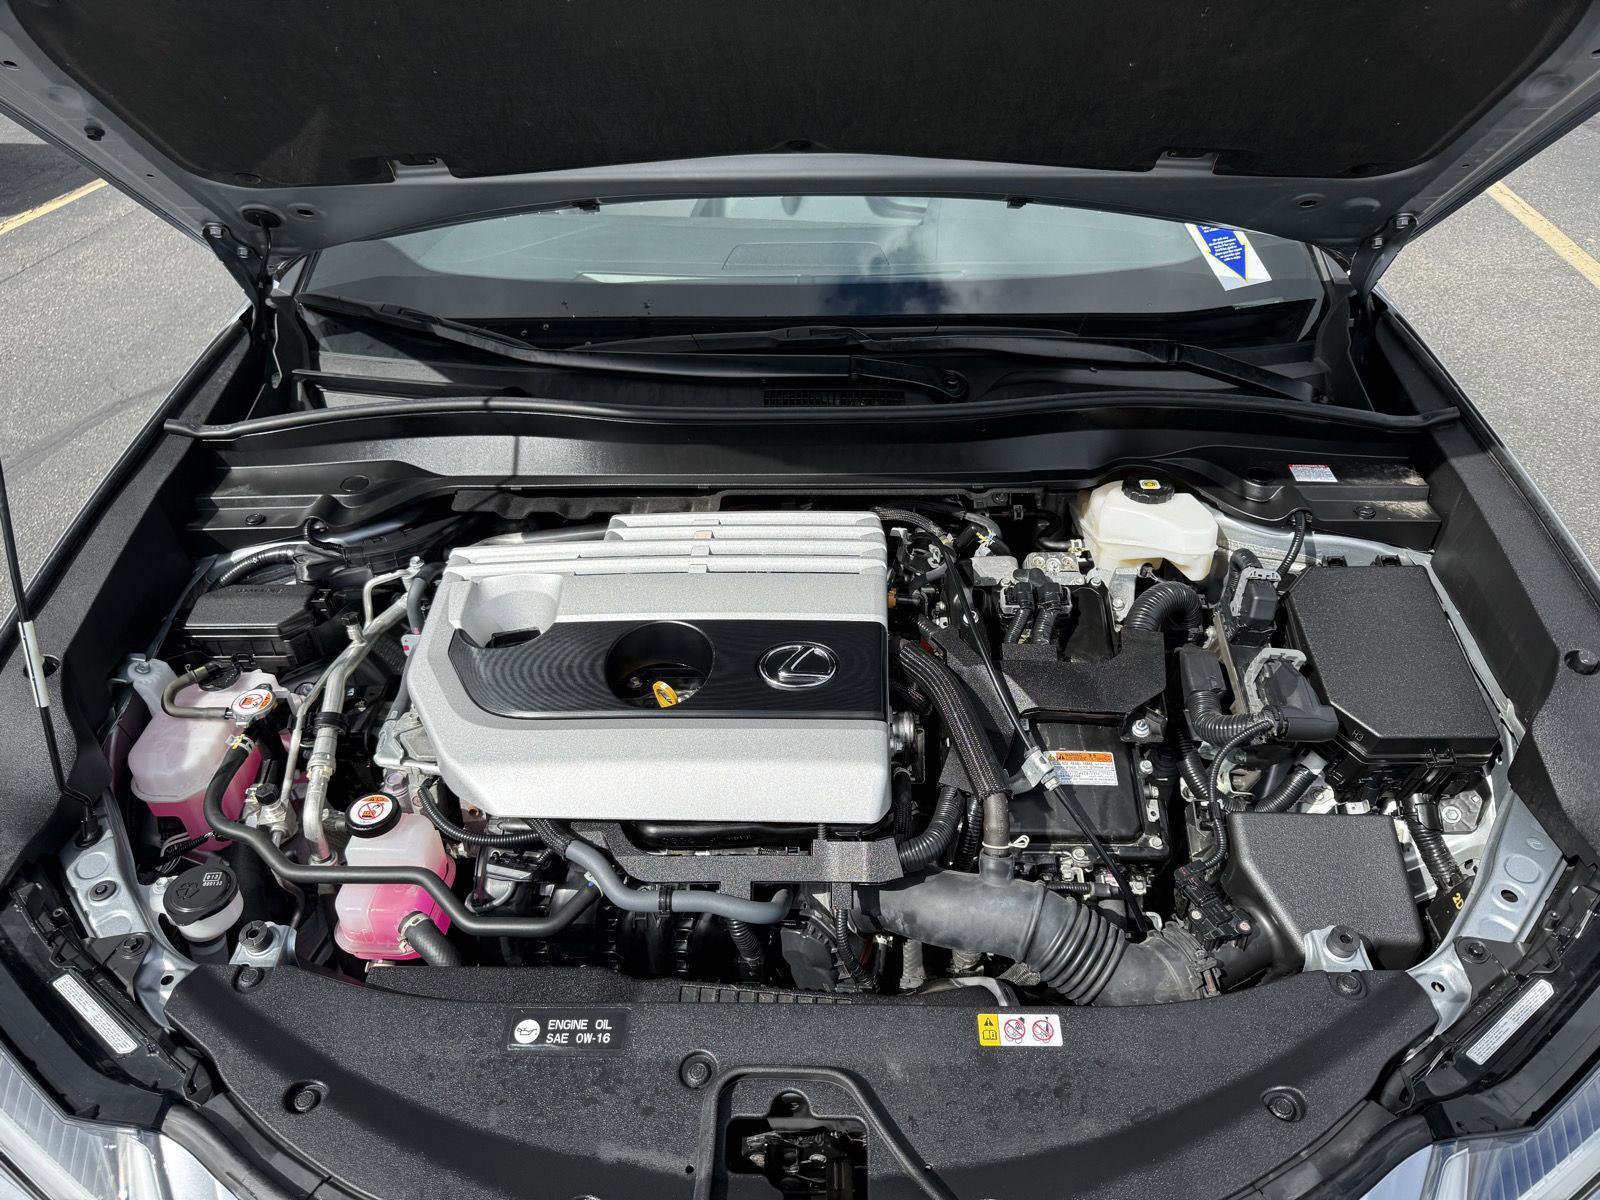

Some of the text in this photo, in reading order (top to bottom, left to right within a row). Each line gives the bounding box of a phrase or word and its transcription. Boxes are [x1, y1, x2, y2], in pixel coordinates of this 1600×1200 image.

[1452, 892, 1464, 910] 2D
[548, 1019, 613, 1030] ENGINE OIL
[546, 1033, 611, 1043] SAE 0W-16
